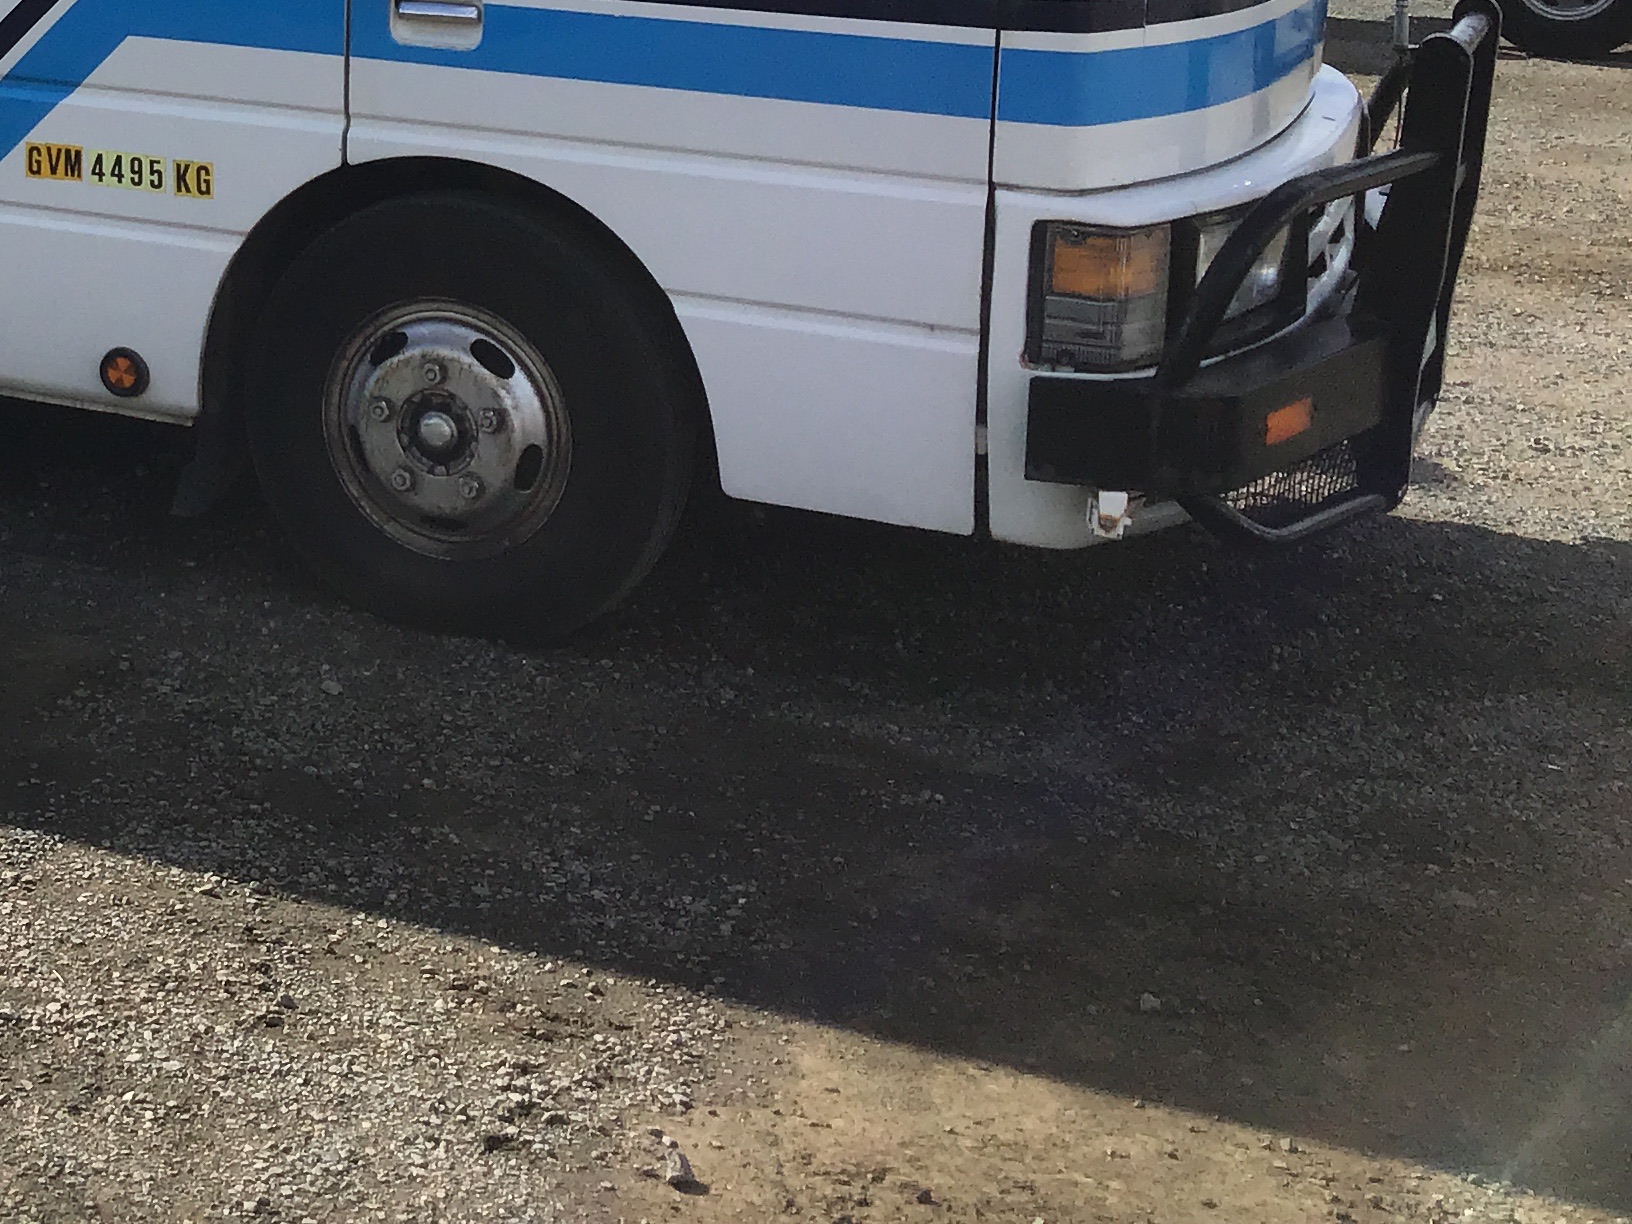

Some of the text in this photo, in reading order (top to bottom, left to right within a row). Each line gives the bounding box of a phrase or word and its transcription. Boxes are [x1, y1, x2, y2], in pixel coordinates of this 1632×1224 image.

[27, 145, 212, 196] GVM 4495 KG
